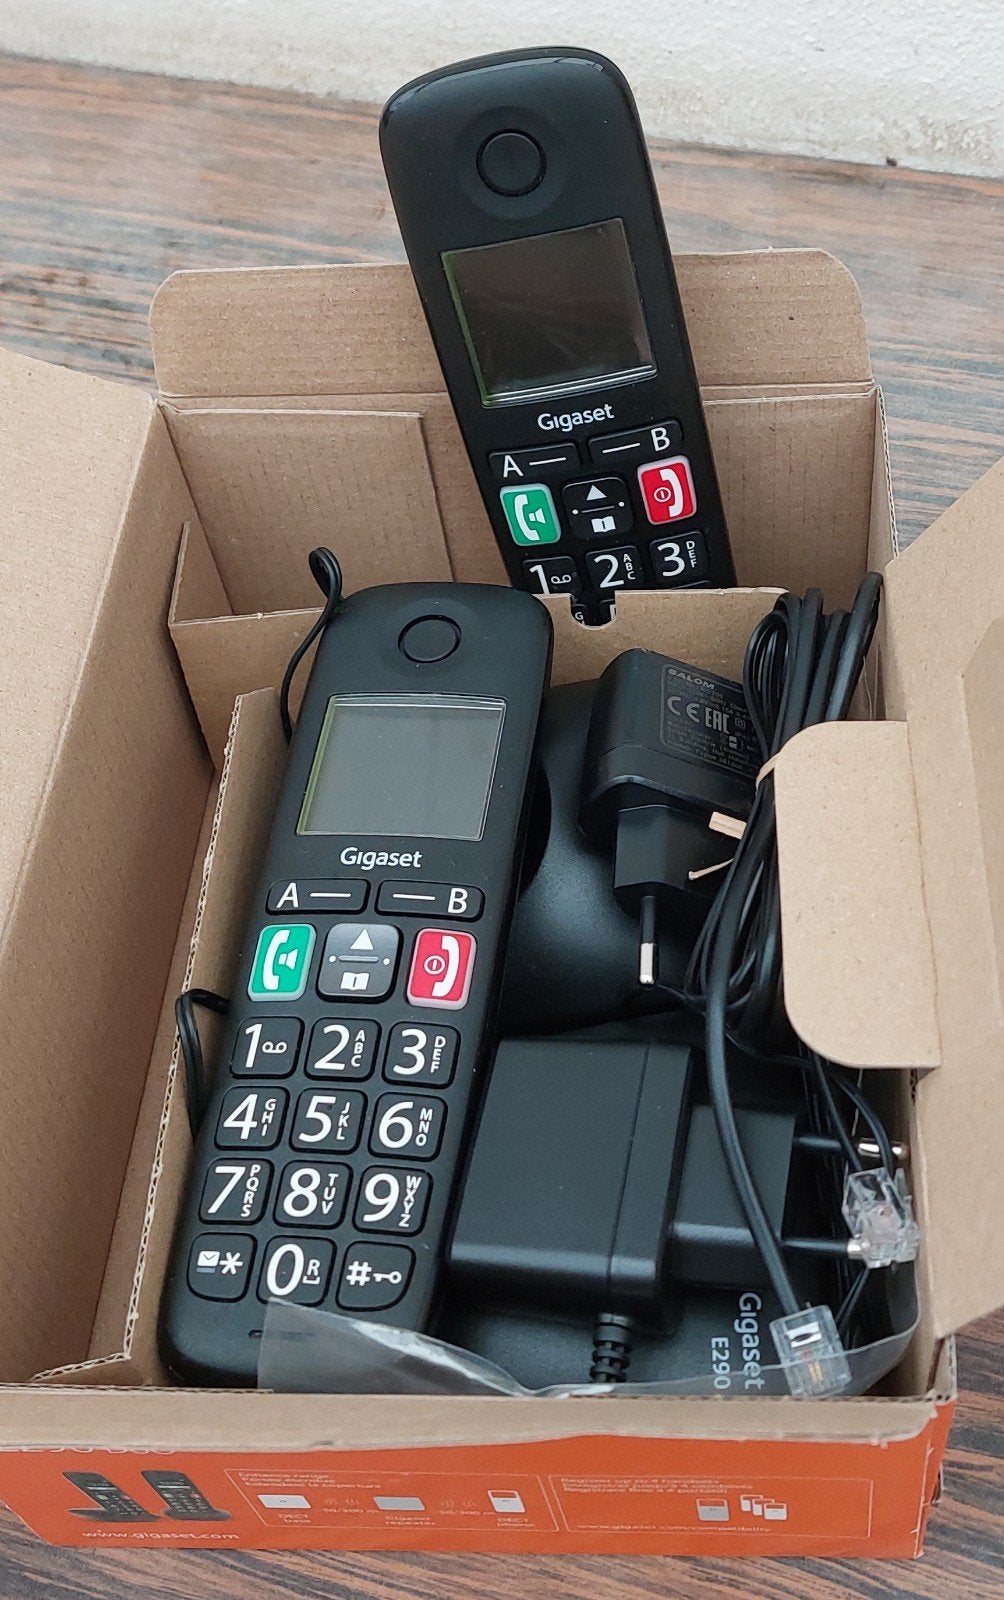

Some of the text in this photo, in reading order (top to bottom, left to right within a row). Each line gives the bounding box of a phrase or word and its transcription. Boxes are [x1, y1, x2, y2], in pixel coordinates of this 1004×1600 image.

[537, 403, 615, 432] Gigaset
[650, 427, 671, 452] B
[502, 455, 524, 478] A
[529, 564, 550, 594] 1
[593, 554, 625, 588] 2
[657, 542, 686, 577] 3
[667, 695, 700, 723] CE
[340, 846, 423, 870] Gigaset
[276, 882, 468, 914] A B
[245, 1023, 263, 1068] 1
[313, 1024, 350, 1071] 2
[392, 1028, 428, 1076] 3
[223, 1093, 258, 1140] 4
[298, 1095, 337, 1143] 5
[378, 1101, 414, 1149] 6
[207, 1165, 246, 1214] 7
[283, 1167, 321, 1218] 8
[362, 1173, 400, 1223] 9
[266, 1243, 305, 1296] 0
[711, 1336, 732, 1390] E290
[733, 1292, 766, 1390] Gigaset
[81, 1530, 240, 1540] www.gigaset.com
